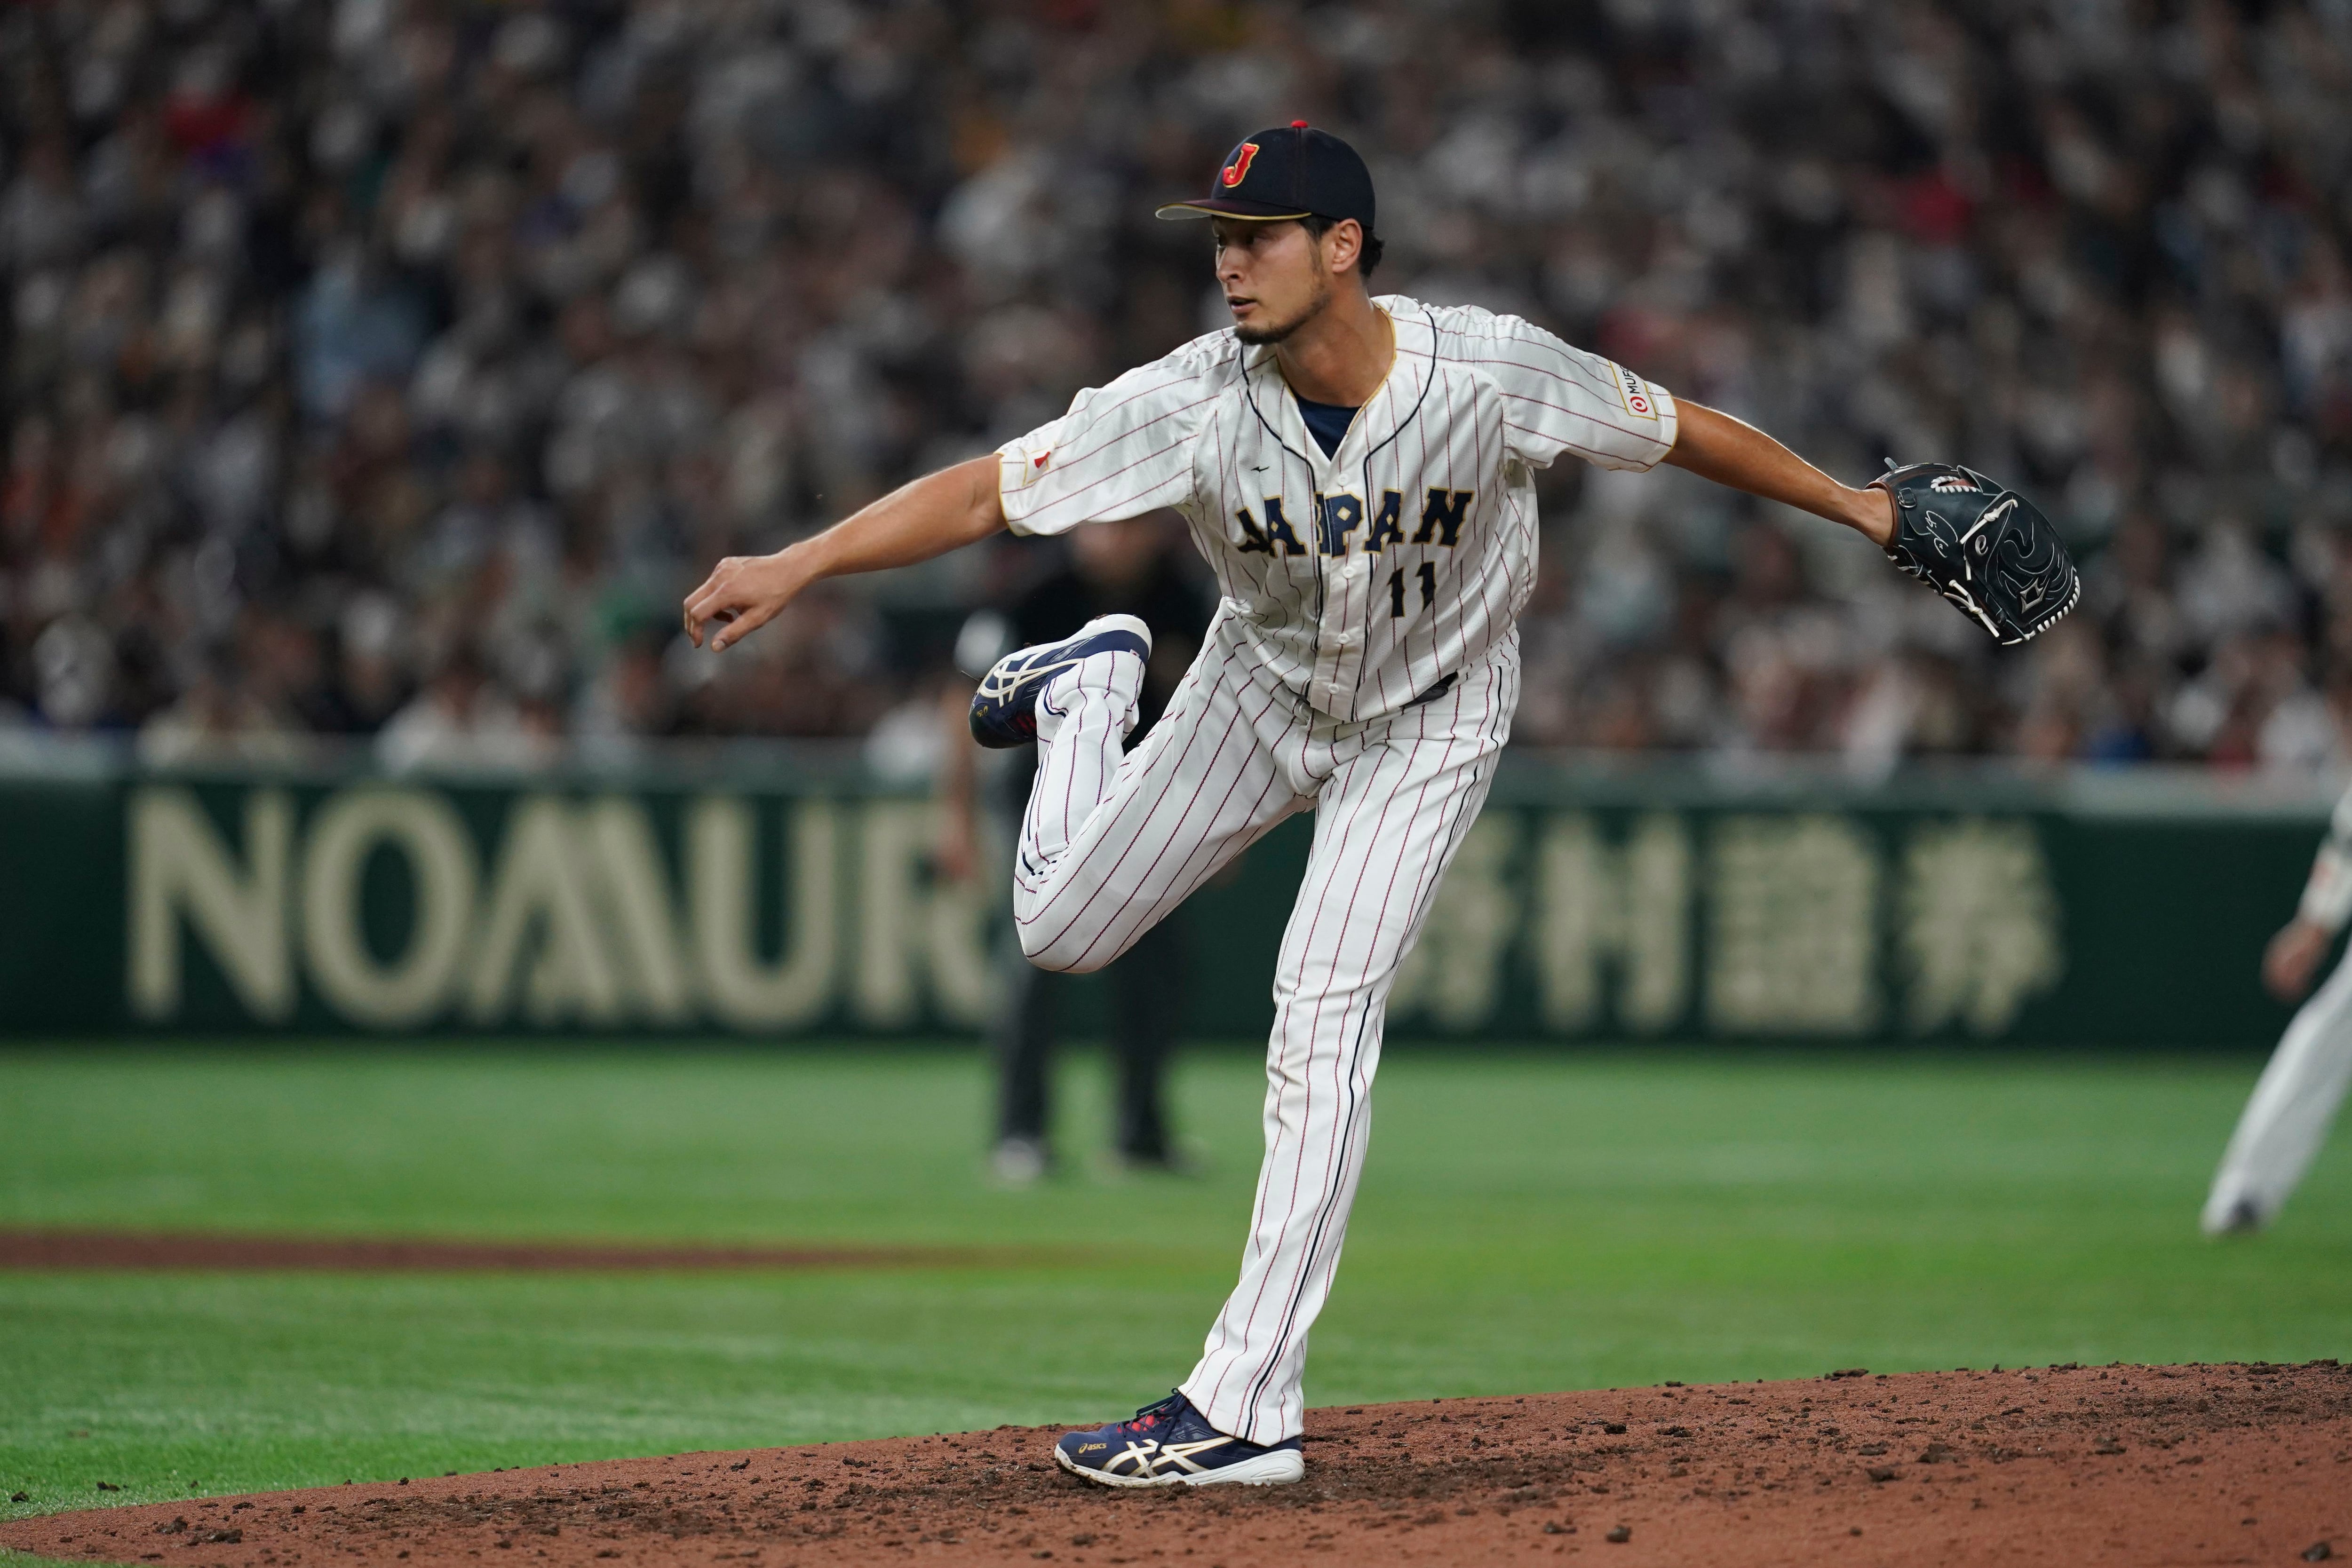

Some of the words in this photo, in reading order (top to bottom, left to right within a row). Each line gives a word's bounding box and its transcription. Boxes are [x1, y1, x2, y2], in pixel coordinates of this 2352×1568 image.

[1223, 143, 1260, 188] J
[1234, 486, 1475, 560] JAPAN
[1386, 561, 1437, 619] 11
[125, 790, 1004, 1021] NOMUR
